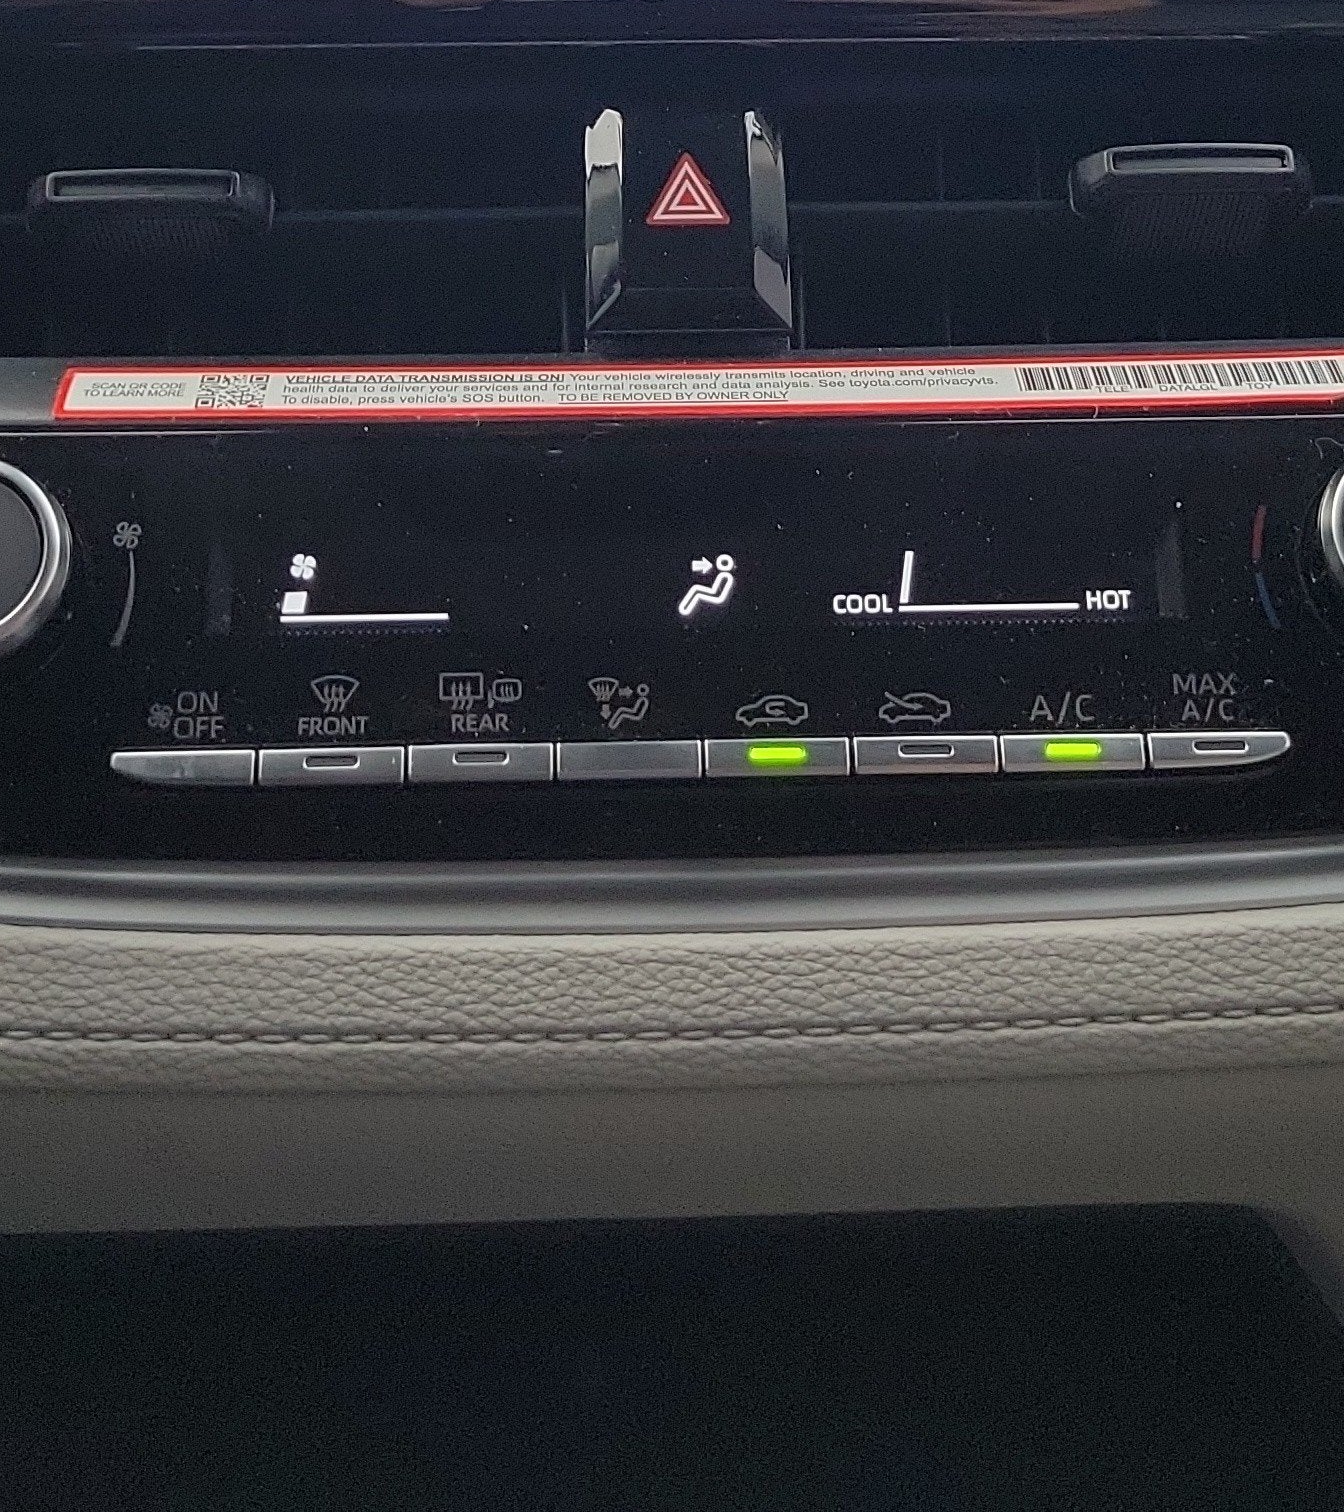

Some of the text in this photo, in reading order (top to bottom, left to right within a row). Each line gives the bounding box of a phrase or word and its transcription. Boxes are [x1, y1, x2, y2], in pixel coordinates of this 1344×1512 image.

[286, 374, 351, 384] VEHICLE
[356, 374, 395, 383] DATA
[400, 374, 515, 383] TRANSMISSION
[520, 373, 533, 382] IS
[570, 373, 600, 381] Your
[605, 373, 651, 381] vehicle
[655, 372, 720, 382] wirelessly
[726, 370, 786, 379] transmits
[790, 370, 846, 379] location,
[850, 368, 895, 379] driving
[900, 368, 924, 377] and
[928, 367, 976, 376] vehicle
[84, 389, 184, 397] TO LEARN MORE
[283, 377, 998, 394] health data to deliver your services and for internal research and data analysis. See toyota.com/privacyvts.
[1246, 382, 1273, 390] TOY
[281, 393, 544, 406] To disable, press vehicle's SOS button.
[558, 390, 789, 402] TO BE REMOVED BY OWNER ONLY
[833, 595, 892, 613] COOL
[1086, 590, 1130, 609] HOT
[1173, 674, 1236, 695] MAX
[178, 692, 218, 713] ON
[1030, 692, 1094, 725] A/C
[1182, 698, 1233, 721] A/C
[174, 716, 223, 738] OFF
[299, 717, 367, 735] FRONT
[452, 714, 508, 731] REAR
